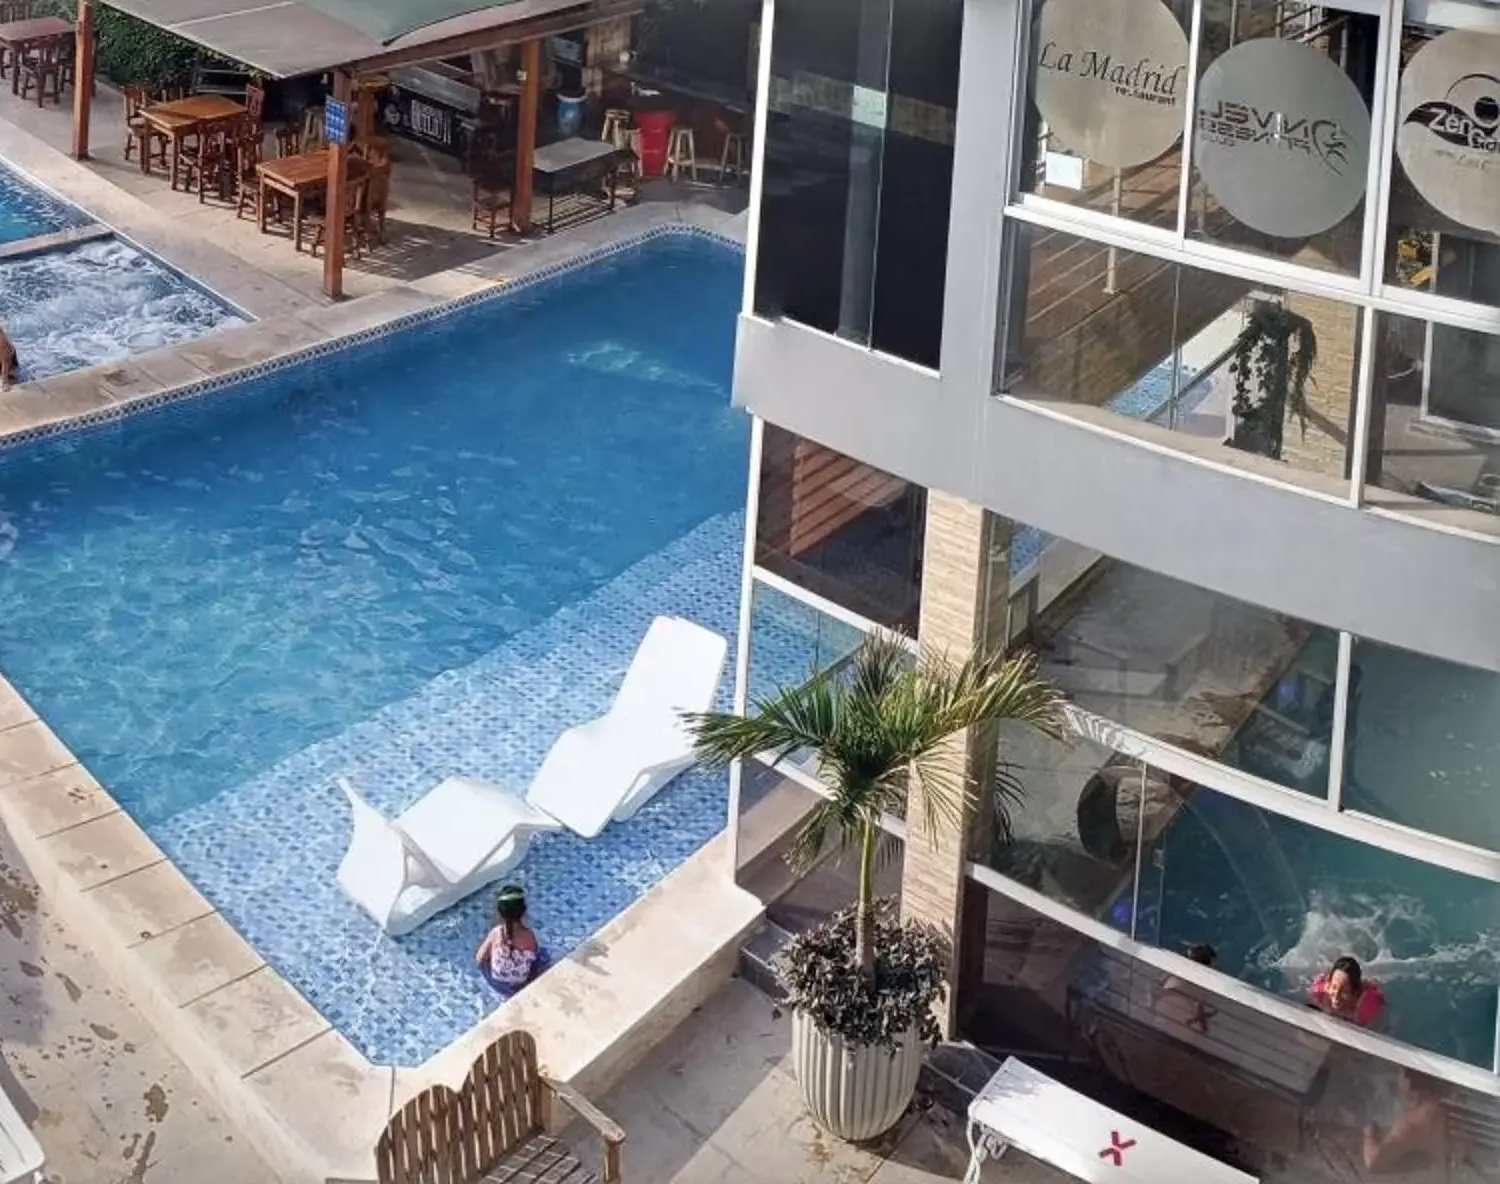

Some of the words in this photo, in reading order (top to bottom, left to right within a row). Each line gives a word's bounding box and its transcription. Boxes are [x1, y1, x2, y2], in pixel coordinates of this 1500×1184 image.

[1037, 41, 1073, 72] La
[1079, 51, 1185, 95] Madrid
[1467, 129, 1500, 153] Ga
